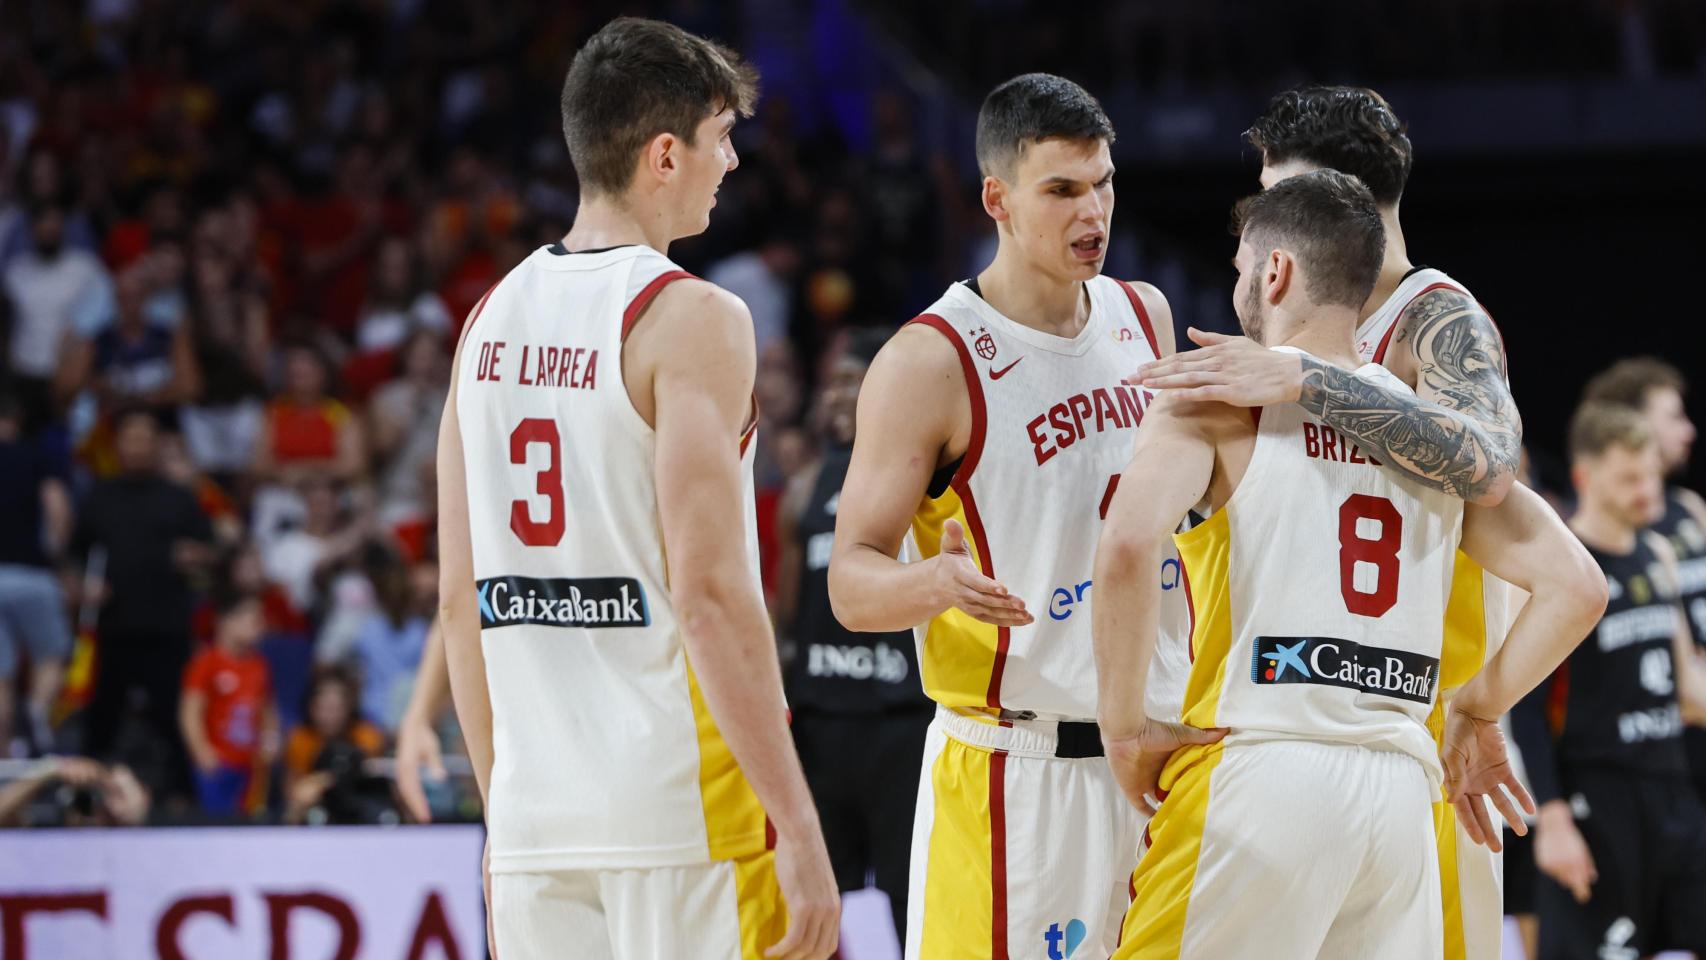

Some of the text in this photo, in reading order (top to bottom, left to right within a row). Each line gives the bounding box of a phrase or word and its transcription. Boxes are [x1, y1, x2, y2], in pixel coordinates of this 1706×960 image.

[477, 342, 598, 390] DE LARREA
[510, 418, 565, 547] 3
[1338, 493, 1402, 618] 8
[491, 582, 642, 623] CaixaBank
[1310, 643, 1432, 698] CaixaBank
